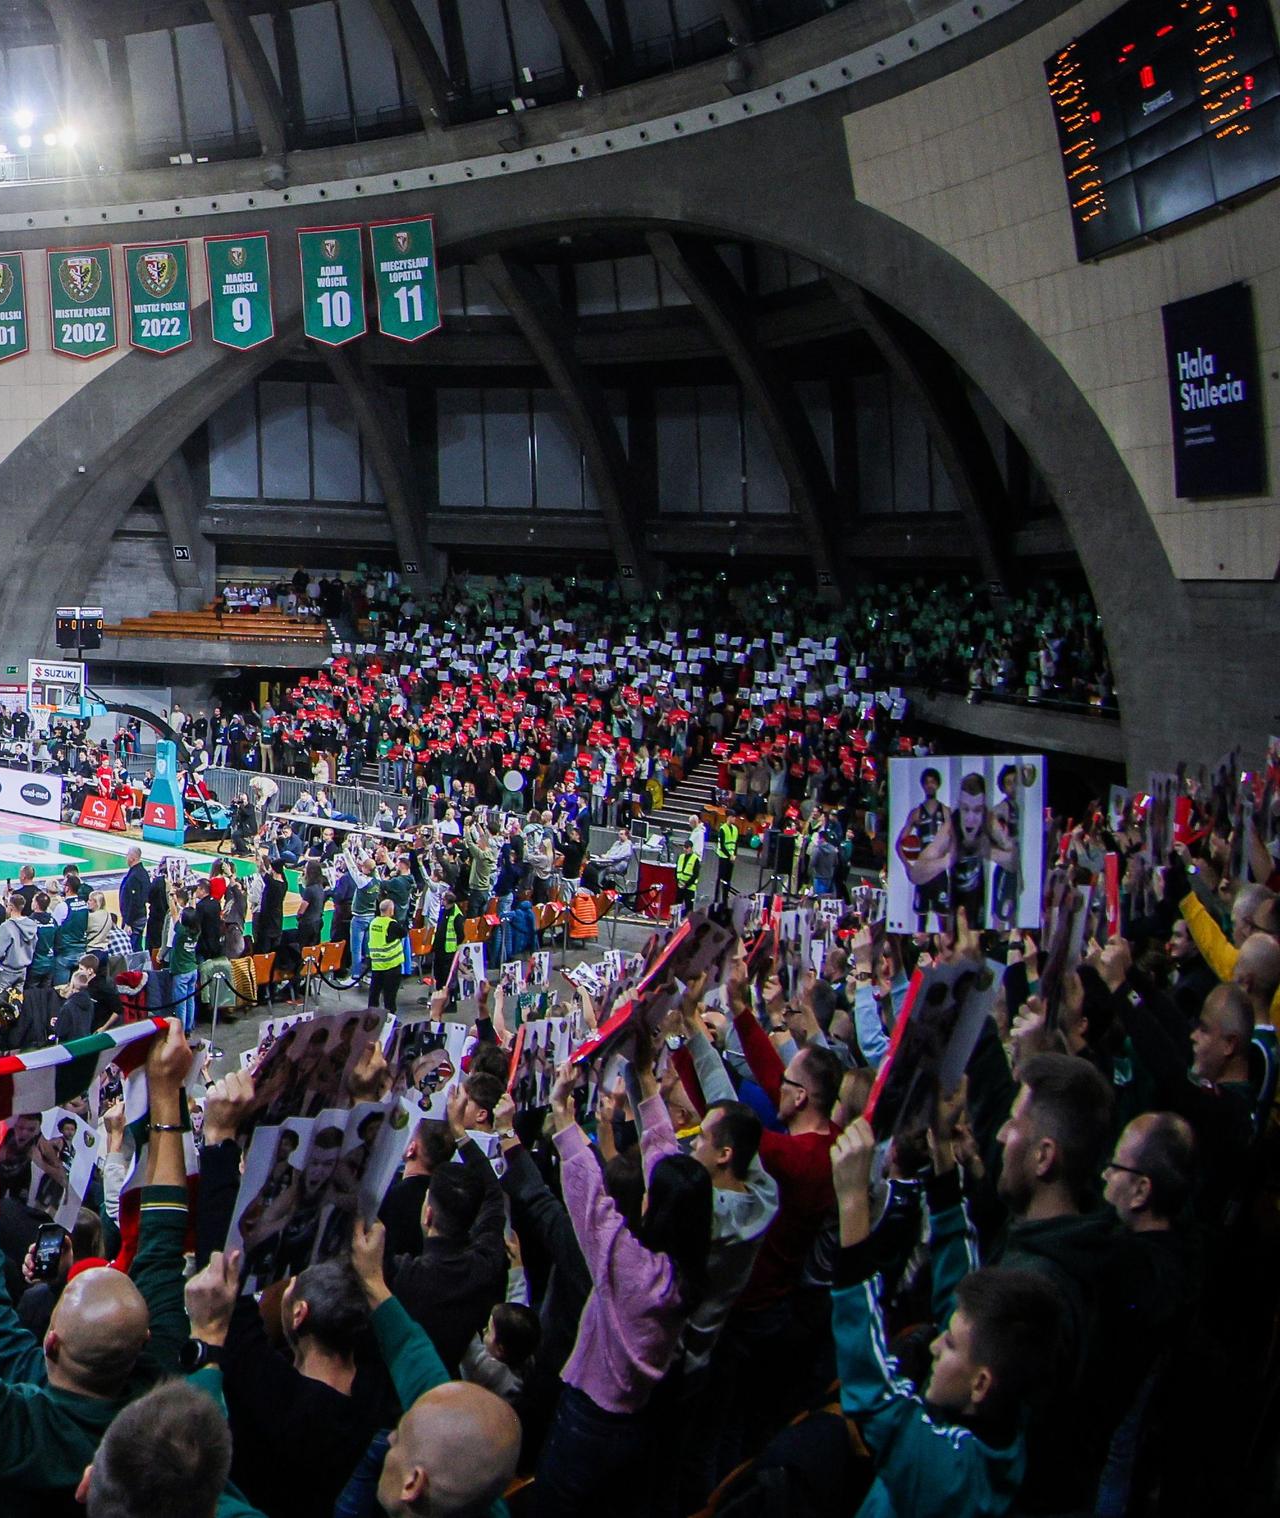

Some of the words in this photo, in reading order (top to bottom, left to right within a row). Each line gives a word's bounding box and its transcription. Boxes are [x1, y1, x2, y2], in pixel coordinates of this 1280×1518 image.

[320, 265, 344, 276] ADAM
[380, 257, 429, 273] MIECZYSŁAW
[225, 272, 253, 283] MACIEJ
[316, 275, 348, 288] WÓJCIK
[389, 269, 423, 283] ŁOPATKA
[222, 282, 258, 294] ZIELIŃSKI
[134, 304, 160, 313] MISTRZ
[161, 302, 186, 311] POLSKI
[316, 290, 352, 328] 10
[393, 285, 423, 323] 11
[55, 309, 82, 318] MISTRZ
[82, 307, 111, 317] POLSKI
[231, 297, 252, 333] 9
[62, 323, 105, 342] 2002
[141, 318, 180, 336] 2022
[1177, 347, 1215, 381] Hala
[1181, 372, 1244, 411] Stulecia
[71, 620, 77, 630] 0
[96, 620, 102, 630] 0
[44, 668, 76, 679] SUZUKI
